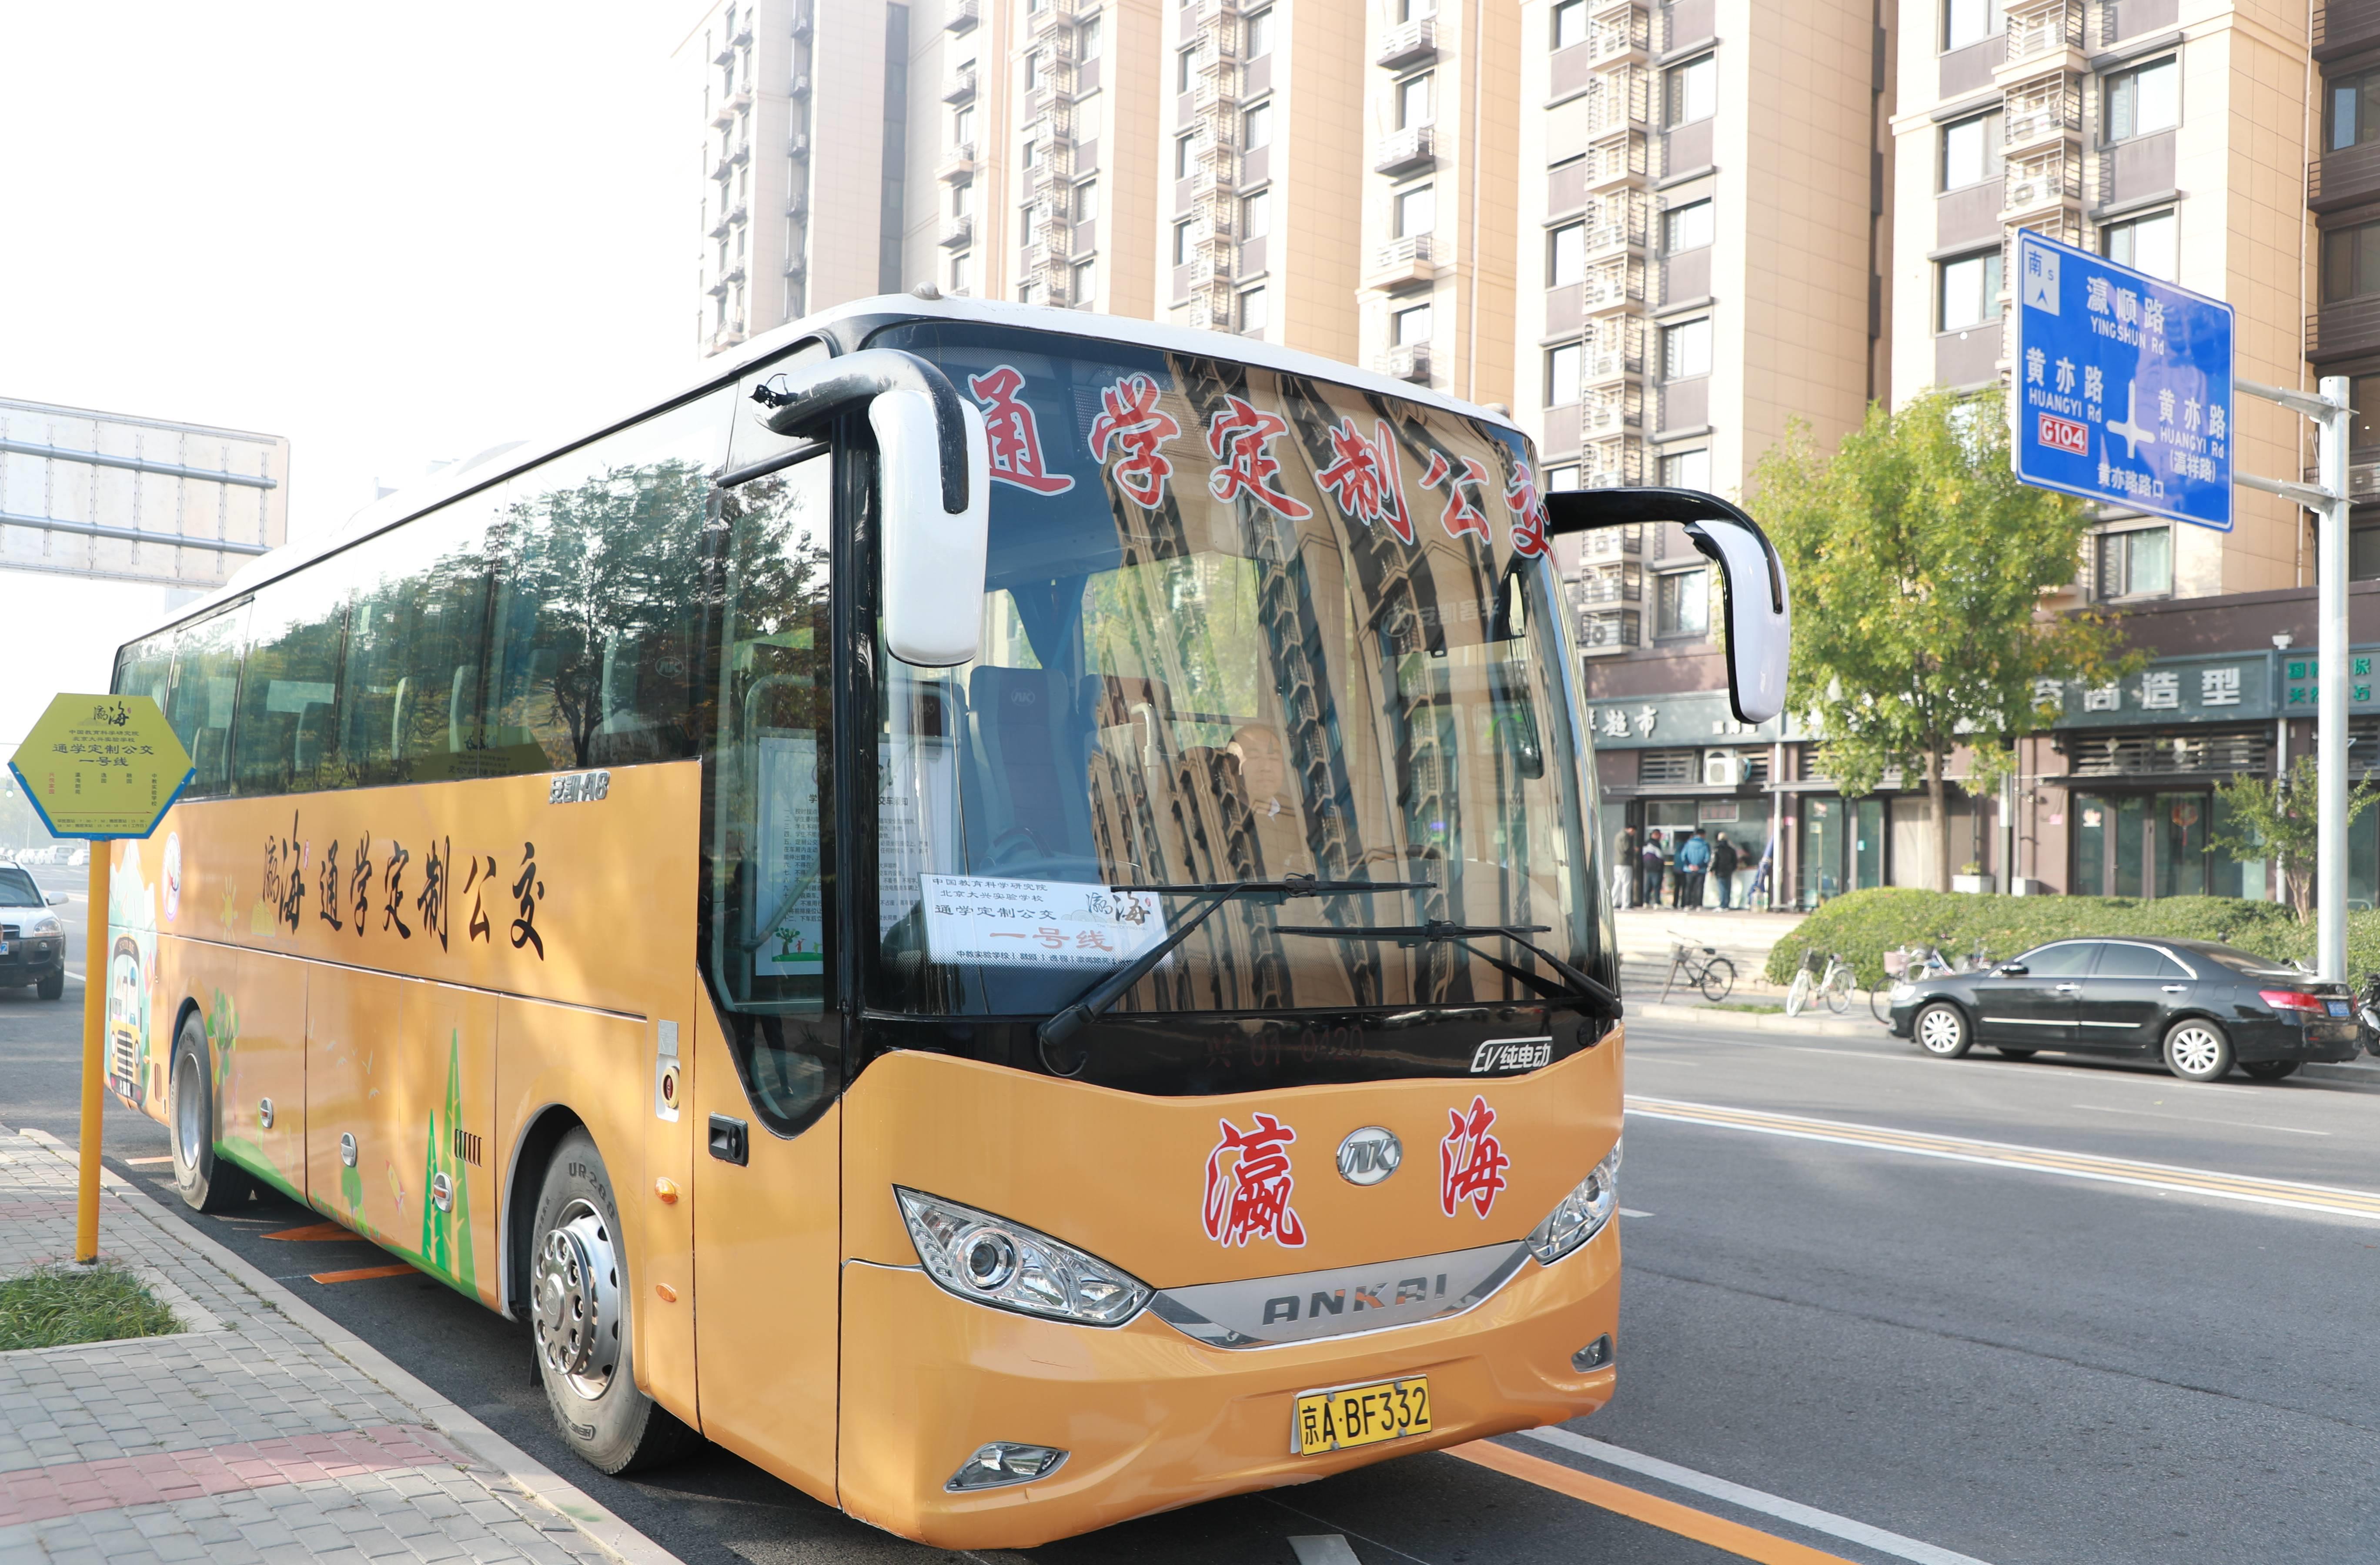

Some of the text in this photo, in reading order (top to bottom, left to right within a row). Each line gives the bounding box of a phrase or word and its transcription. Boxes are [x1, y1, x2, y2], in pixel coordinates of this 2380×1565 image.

[2029, 251, 2042, 277] 南
[2048, 269, 2055, 281] S
[2087, 276, 2165, 334] 瀛顺路
[2090, 315, 2164, 356] YINGSHUN Rd
[2026, 346, 2104, 404] 黄亦路
[2029, 387, 2102, 424] HUANGYI Rd
[2158, 388, 2226, 441] 黄亦路
[2042, 420, 2085, 450] G104
[2160, 426, 2224, 459] HUANGYI Rd
[968, 364, 1552, 560] 通学定制公交
[2097, 462, 2165, 500] 黄亦路路口
[52, 743, 154, 755] 通学定制公交
[79, 756, 130, 767] 一号线
[320, 830, 545, 962] 通学定制公交
[932, 878, 1048, 891] 中国教育科学研究院
[940, 890, 1044, 902] 北京大兴实验学校
[935, 905, 1057, 920] 通学定制公交
[989, 926, 1113, 951] 一号线
[1251, 1025, 1364, 1067] 01 0420
[1470, 1037, 1552, 1073] EV纯电动
[1202, 1094, 1511, 1249] 瀛 海
[1262, 1273, 1447, 1326] ANKAI
